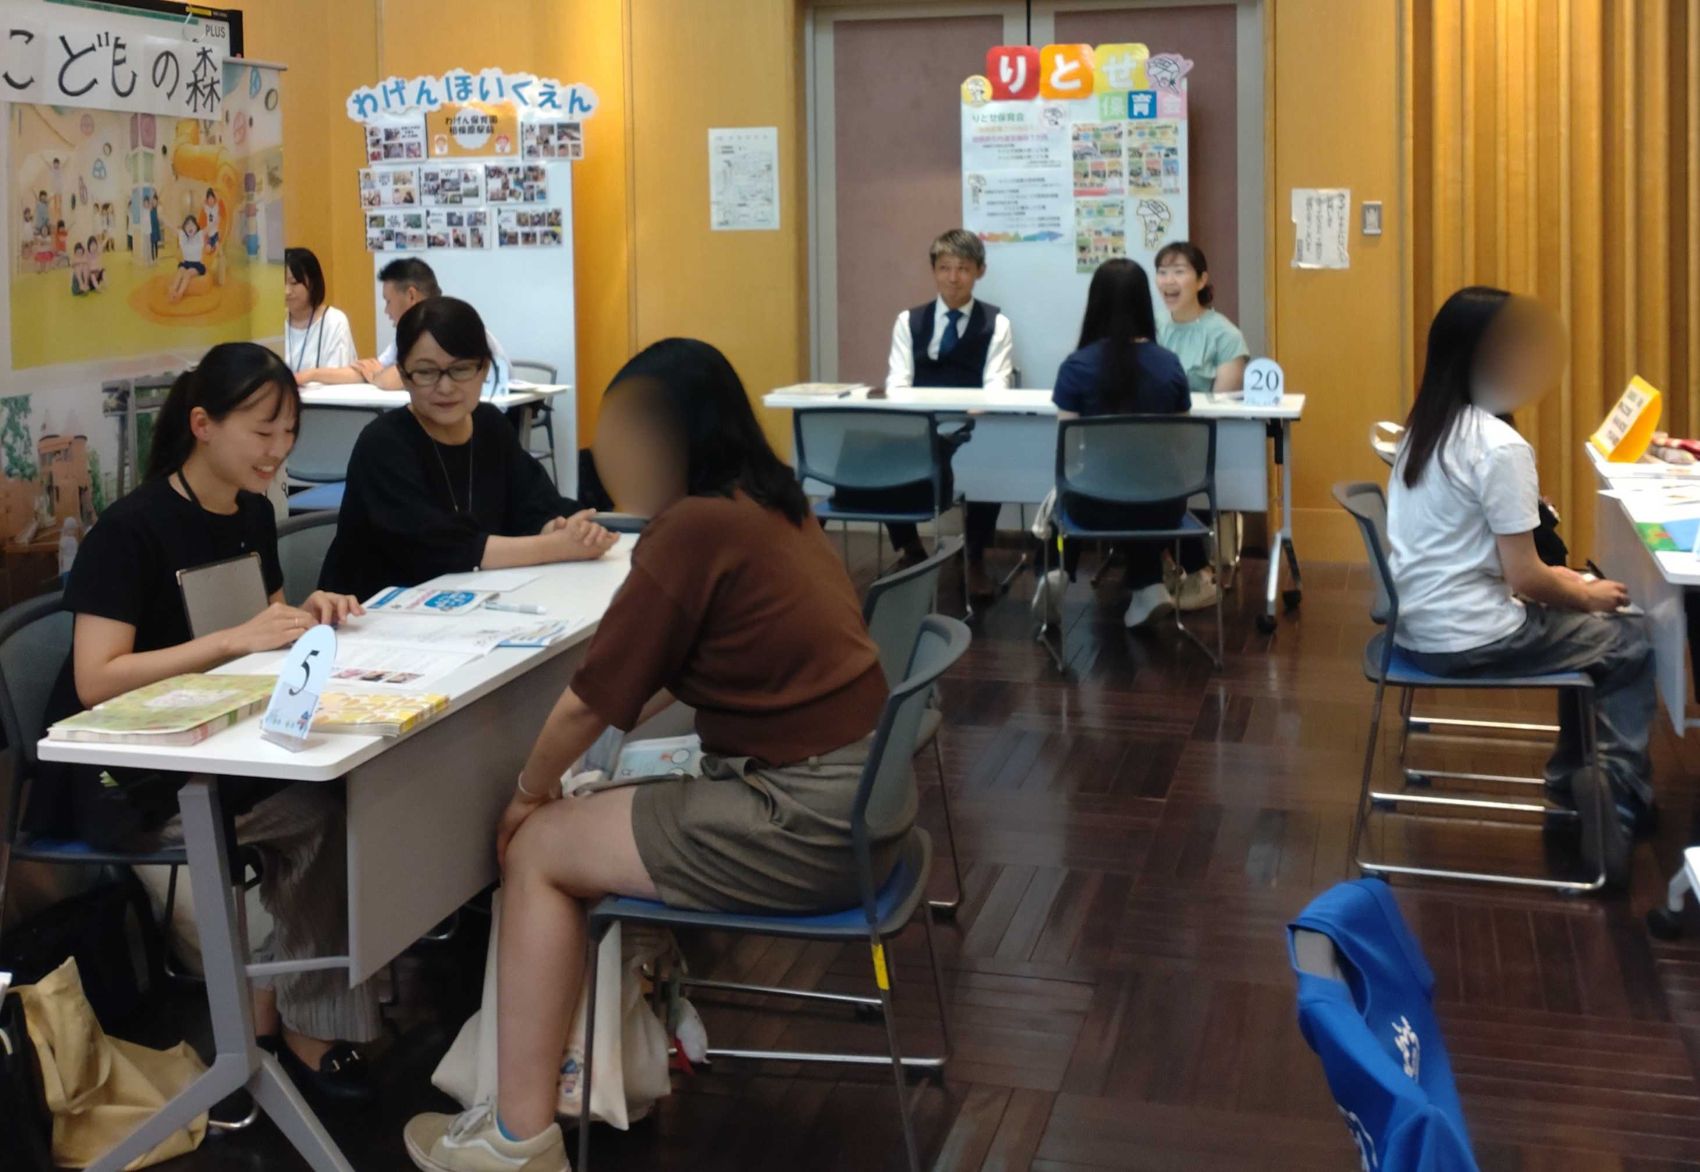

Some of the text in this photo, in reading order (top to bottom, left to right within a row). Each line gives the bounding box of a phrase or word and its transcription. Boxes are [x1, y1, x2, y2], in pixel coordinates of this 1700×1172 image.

[205, 24, 226, 38] PLUS
[2, 30, 221, 113] こどもの森
[1000, 54, 1137, 94] りとせ
[353, 75, 592, 118] わげんほいくえん
[1250, 369, 1279, 391] 20
[288, 650, 320, 696] 5
